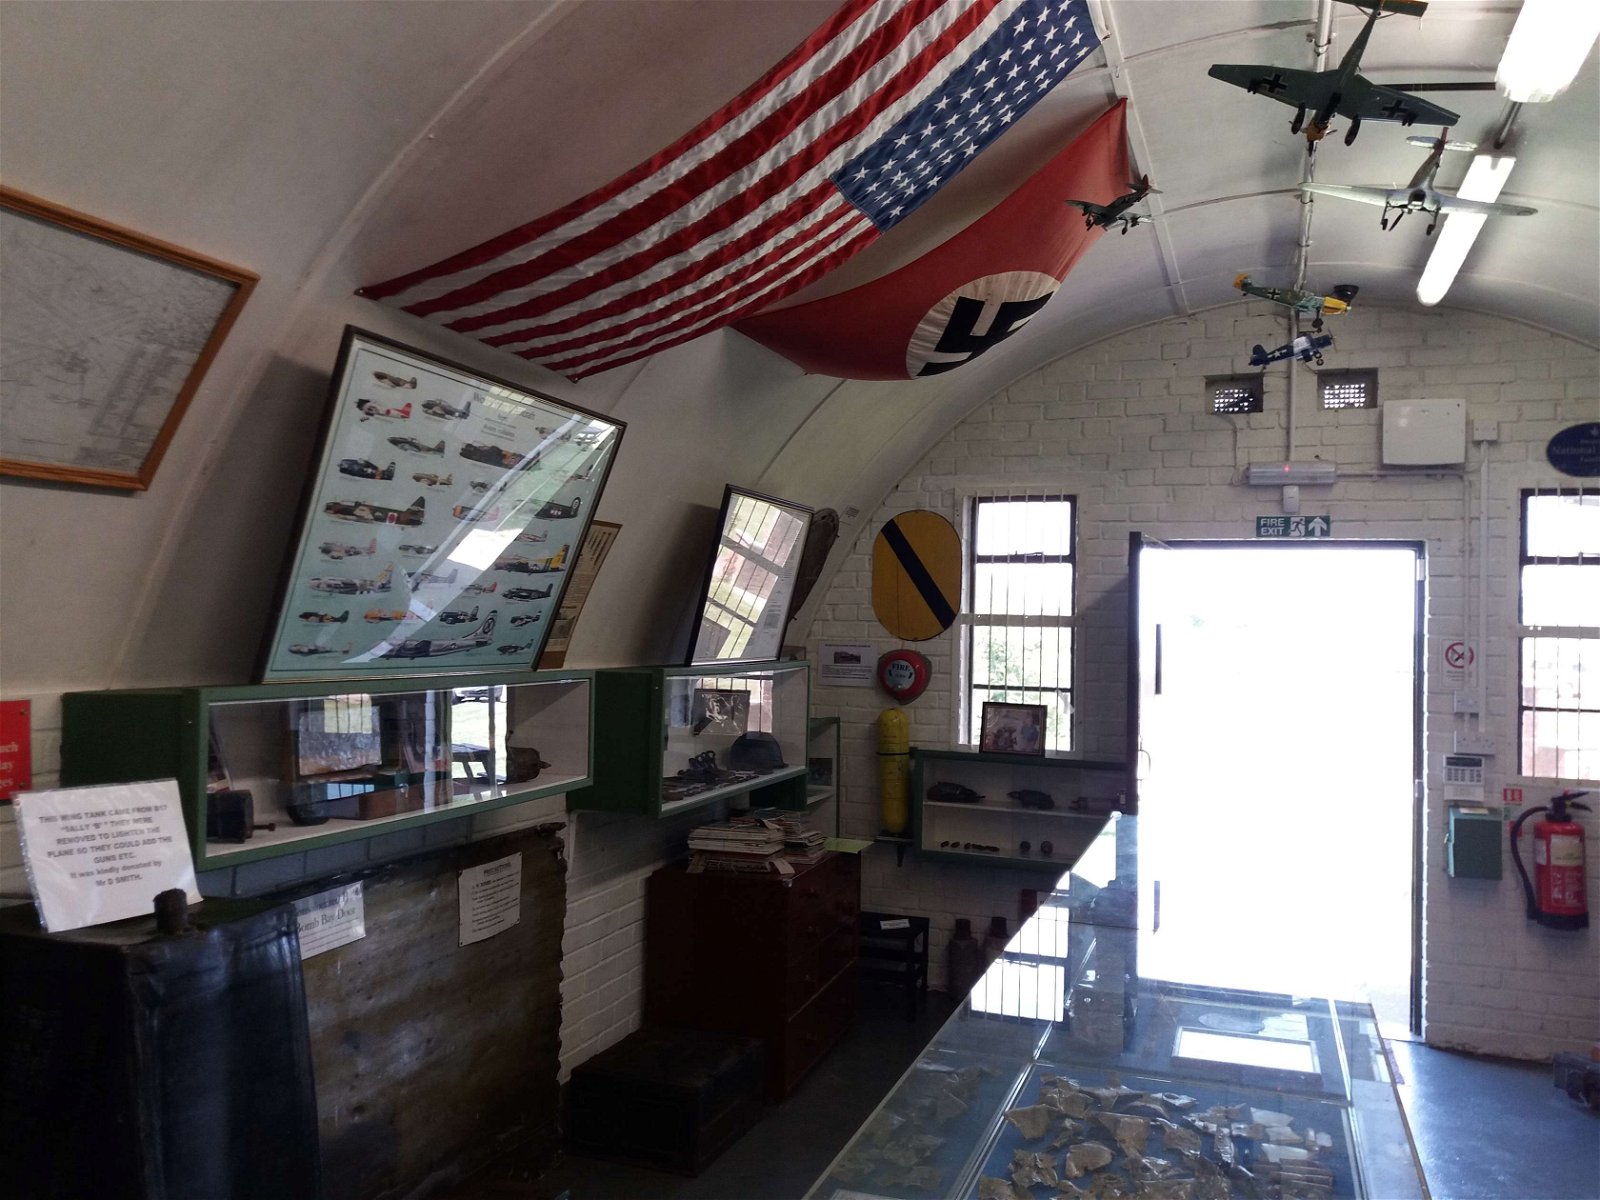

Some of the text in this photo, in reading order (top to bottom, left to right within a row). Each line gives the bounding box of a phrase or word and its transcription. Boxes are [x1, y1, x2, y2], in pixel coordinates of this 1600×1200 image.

[1261, 518, 1285, 526] FIRE
[1261, 527, 1285, 535] EXIT
[39, 816, 58, 824] THIS
[61, 813, 82, 822] WING
[84, 810, 106, 820] TANK
[108, 808, 130, 817] CAME
[132, 805, 152, 814] FROM
[110, 819, 130, 828] THEY
[56, 826, 160, 845] REMOVED TO LIGHTEN THE
[47, 836, 172, 858] PLANE SO THEY COULD ADD THE
[93, 852, 137, 864] GUNS ETC.
[79, 870, 94, 878] was
[96, 866, 120, 876] kindly
[121, 862, 152, 872] donated
[115, 874, 143, 884] SMITH.
[298, 917, 320, 932] Bomb
[321, 913, 336, 926] Bay
